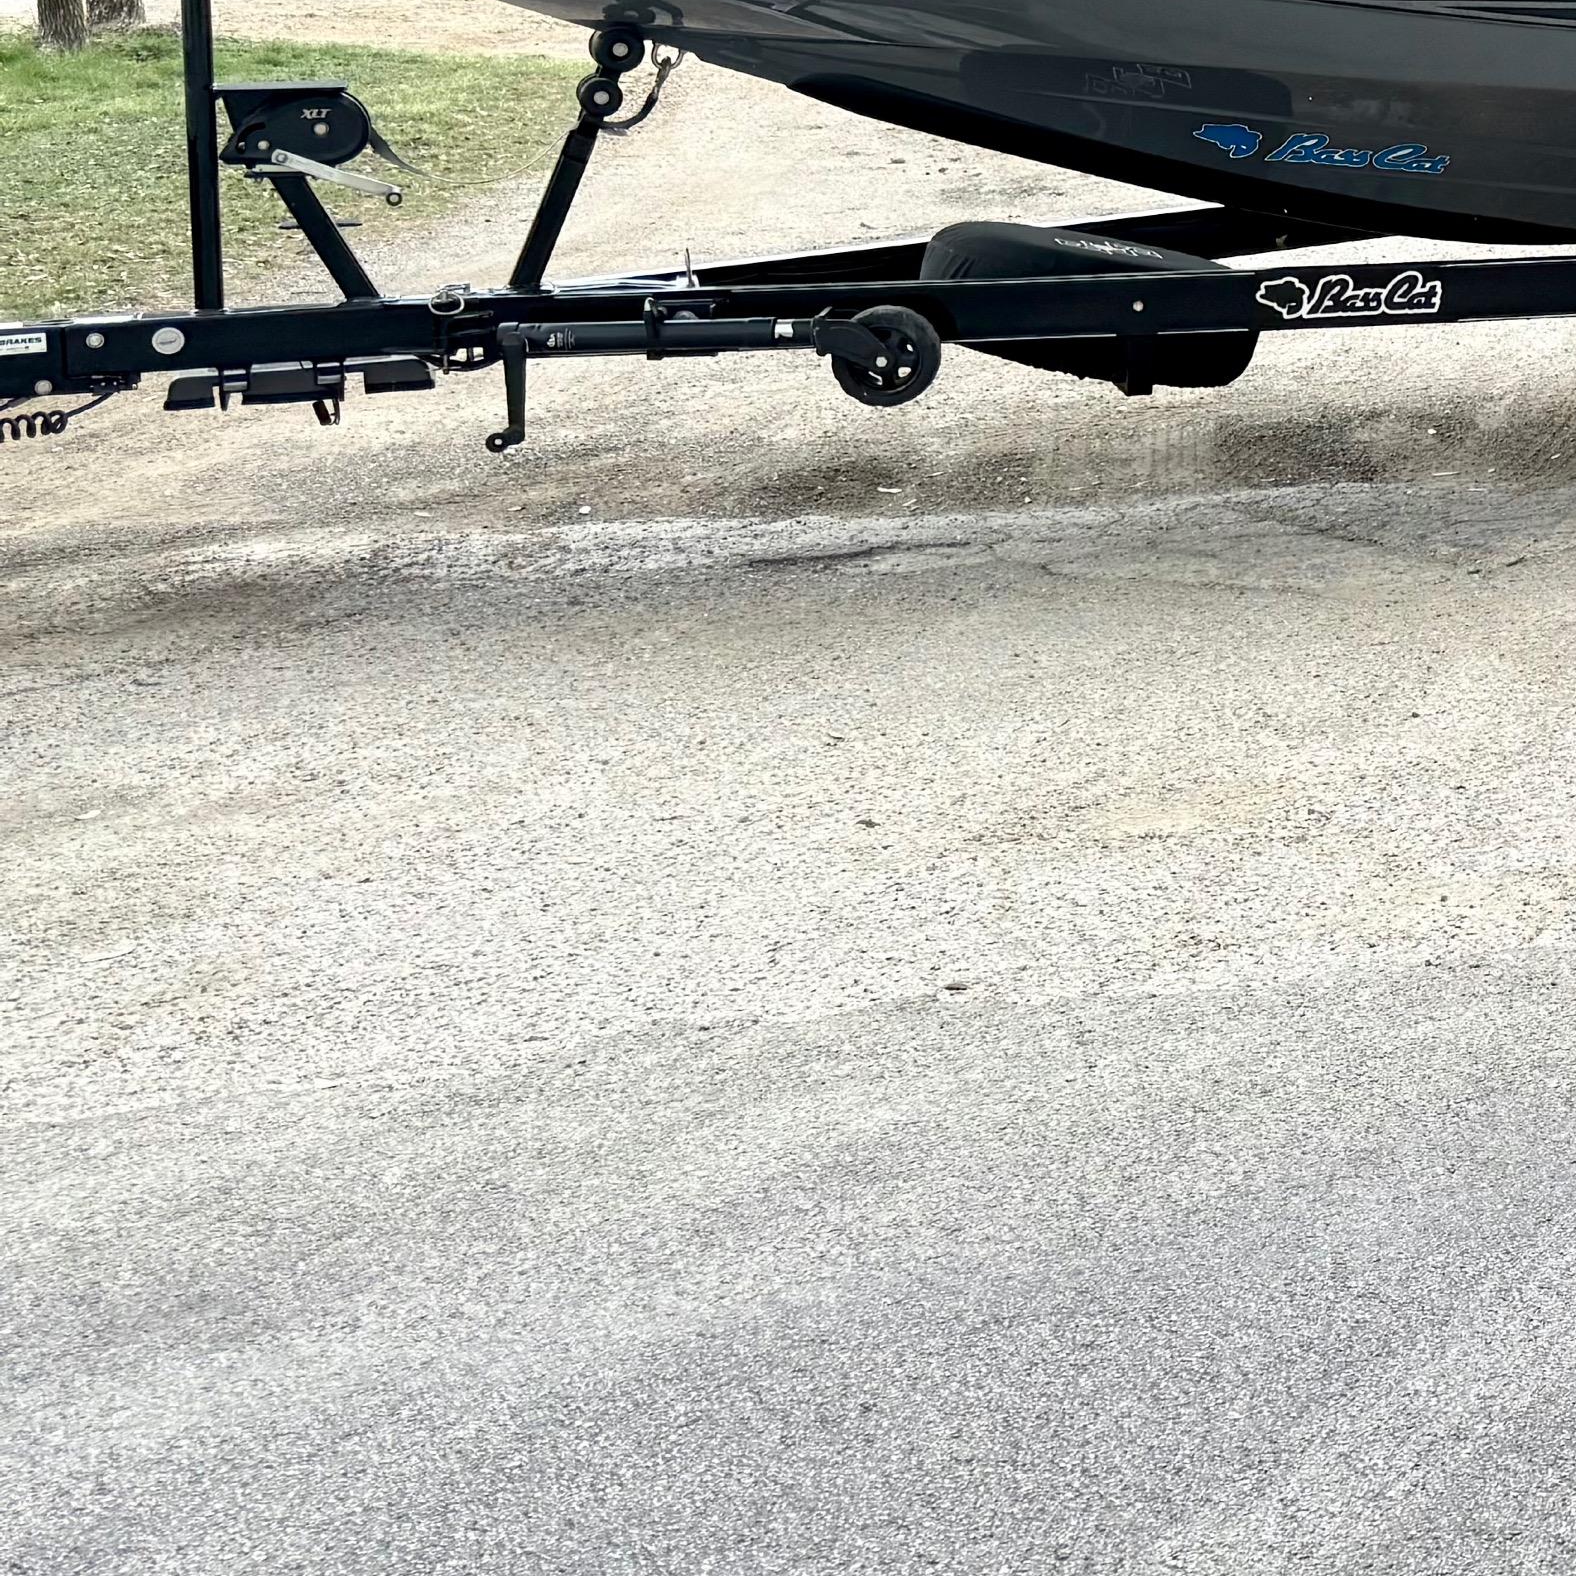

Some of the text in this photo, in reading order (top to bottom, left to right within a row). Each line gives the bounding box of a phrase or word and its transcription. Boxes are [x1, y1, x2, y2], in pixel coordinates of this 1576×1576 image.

[300, 108, 333, 120] XLT
[1264, 133, 1451, 174] Bass Cat
[1302, 270, 1443, 319] Bass Cat
